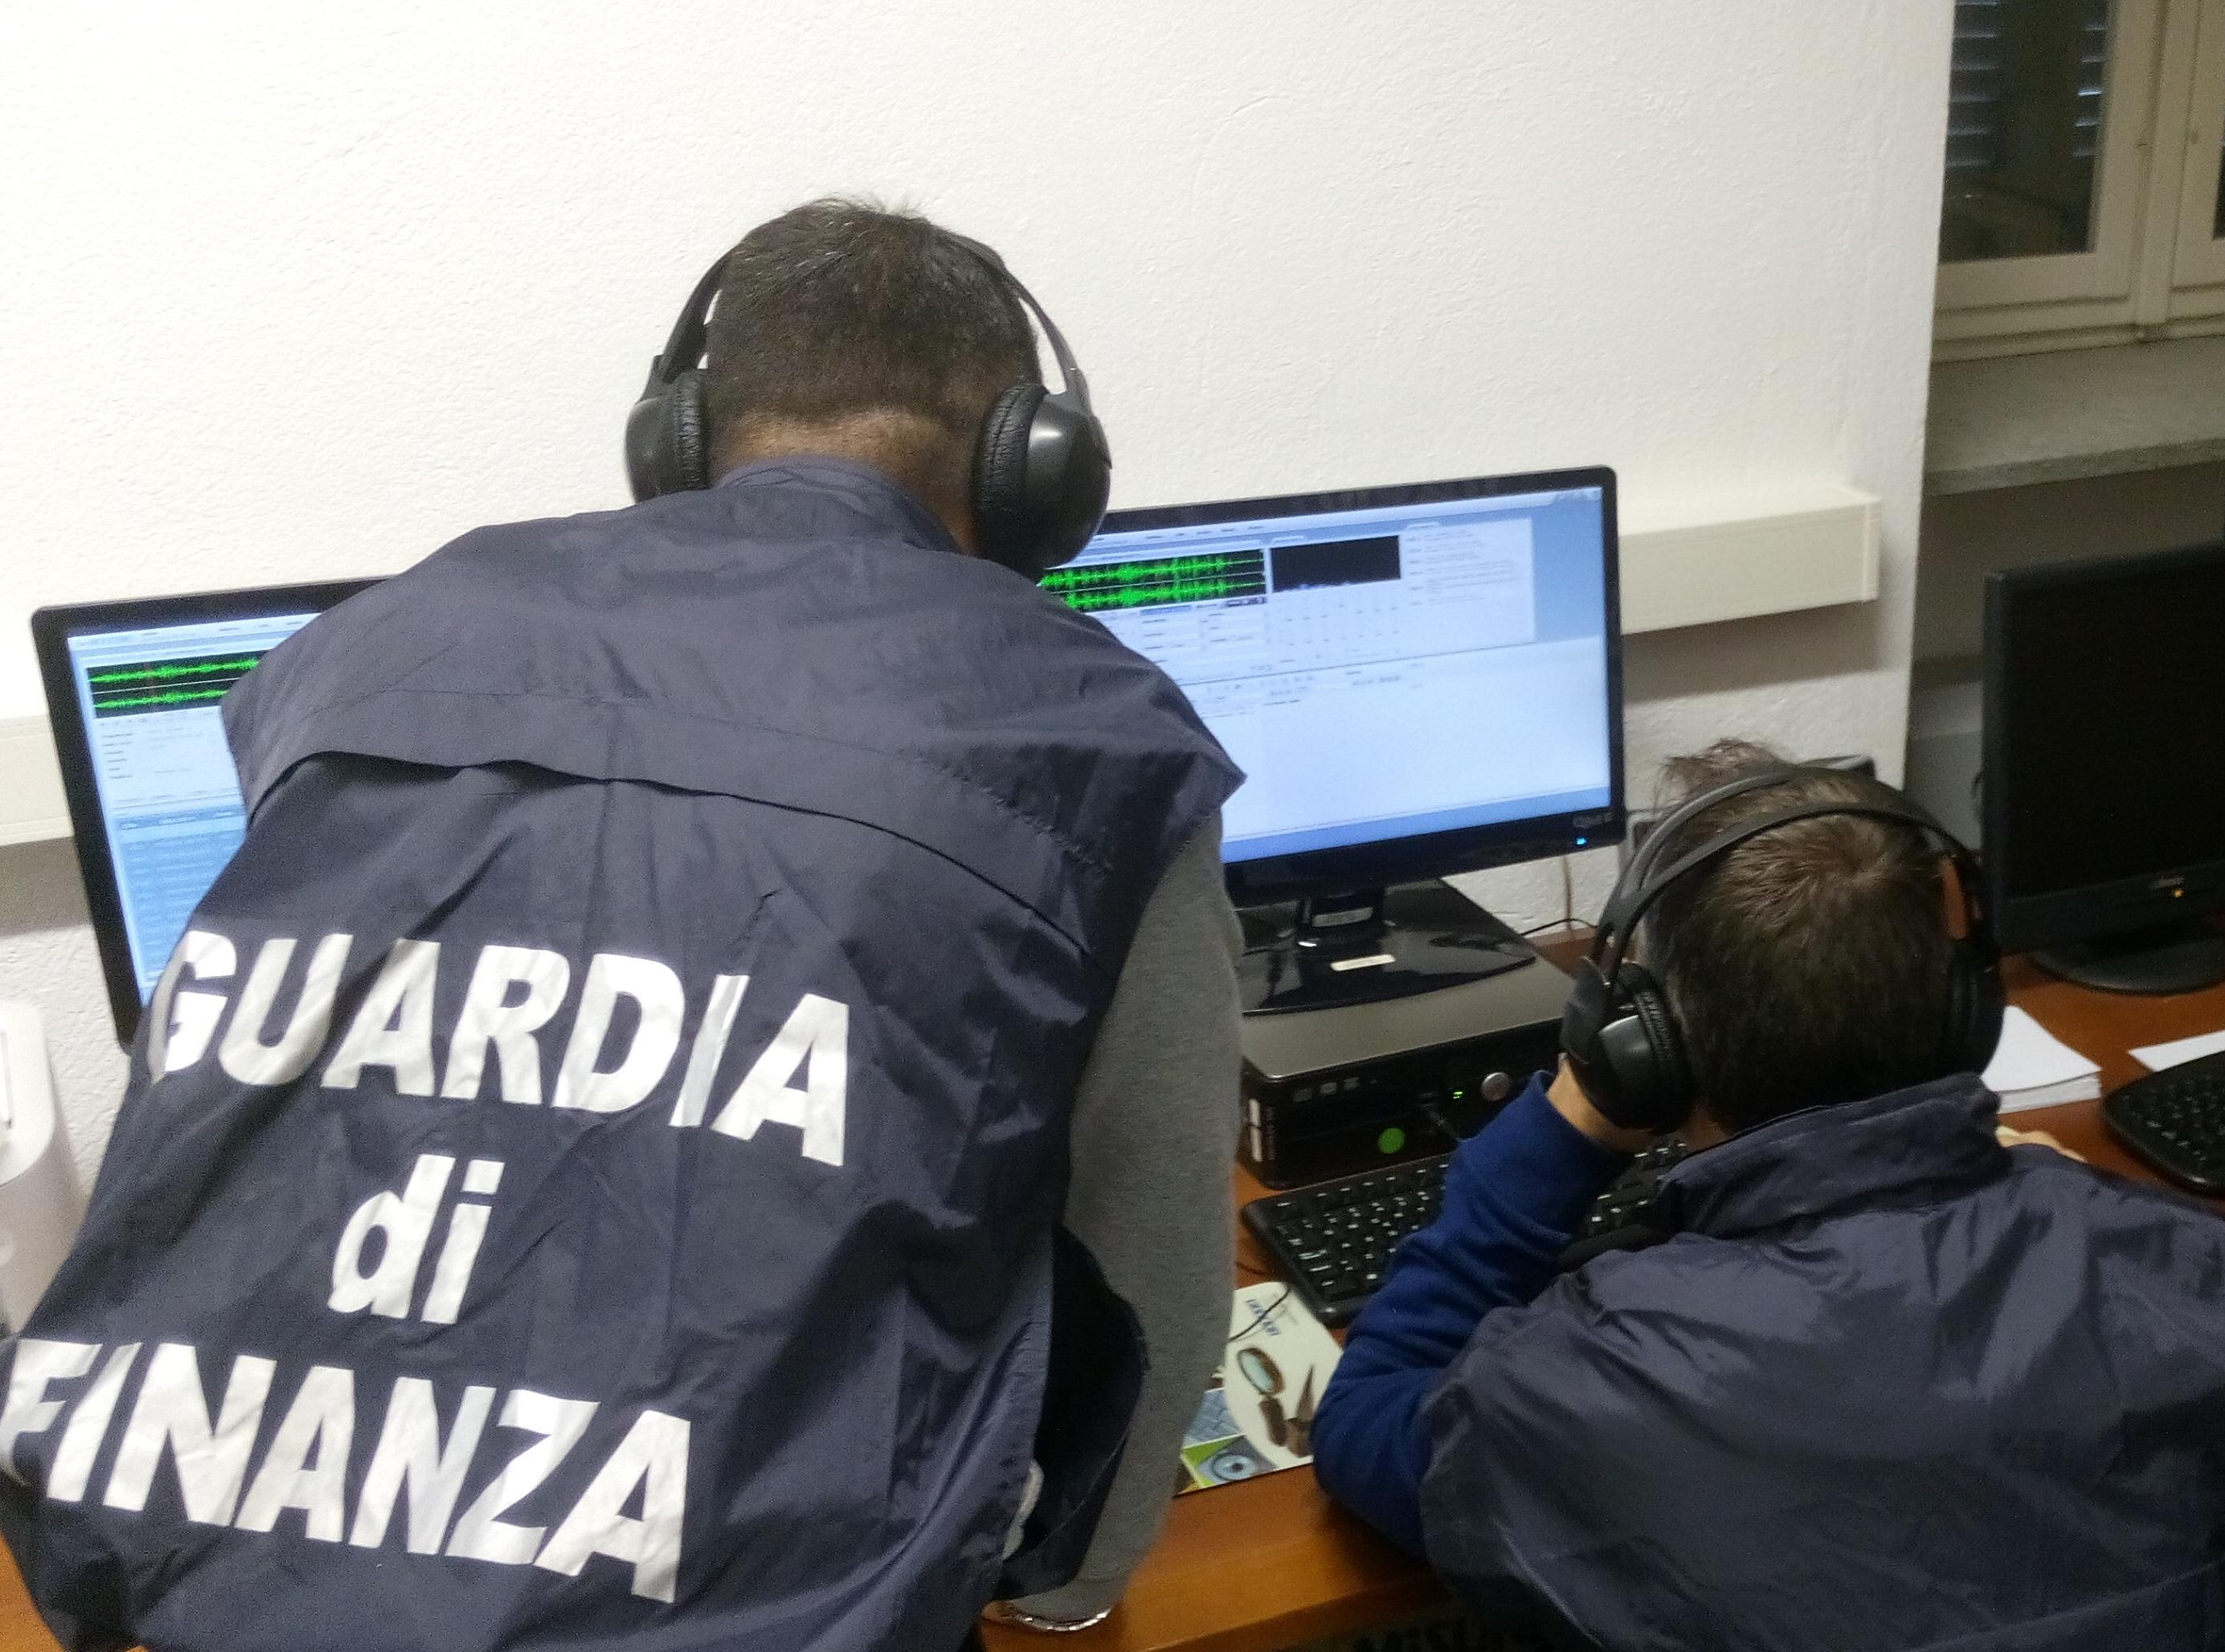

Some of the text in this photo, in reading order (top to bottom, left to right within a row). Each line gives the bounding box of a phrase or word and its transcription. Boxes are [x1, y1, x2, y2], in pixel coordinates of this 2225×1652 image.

[148, 931, 849, 1166] GUARDIA
[328, 1155, 505, 1323] di
[0, 1339, 691, 1604] FINANZA
